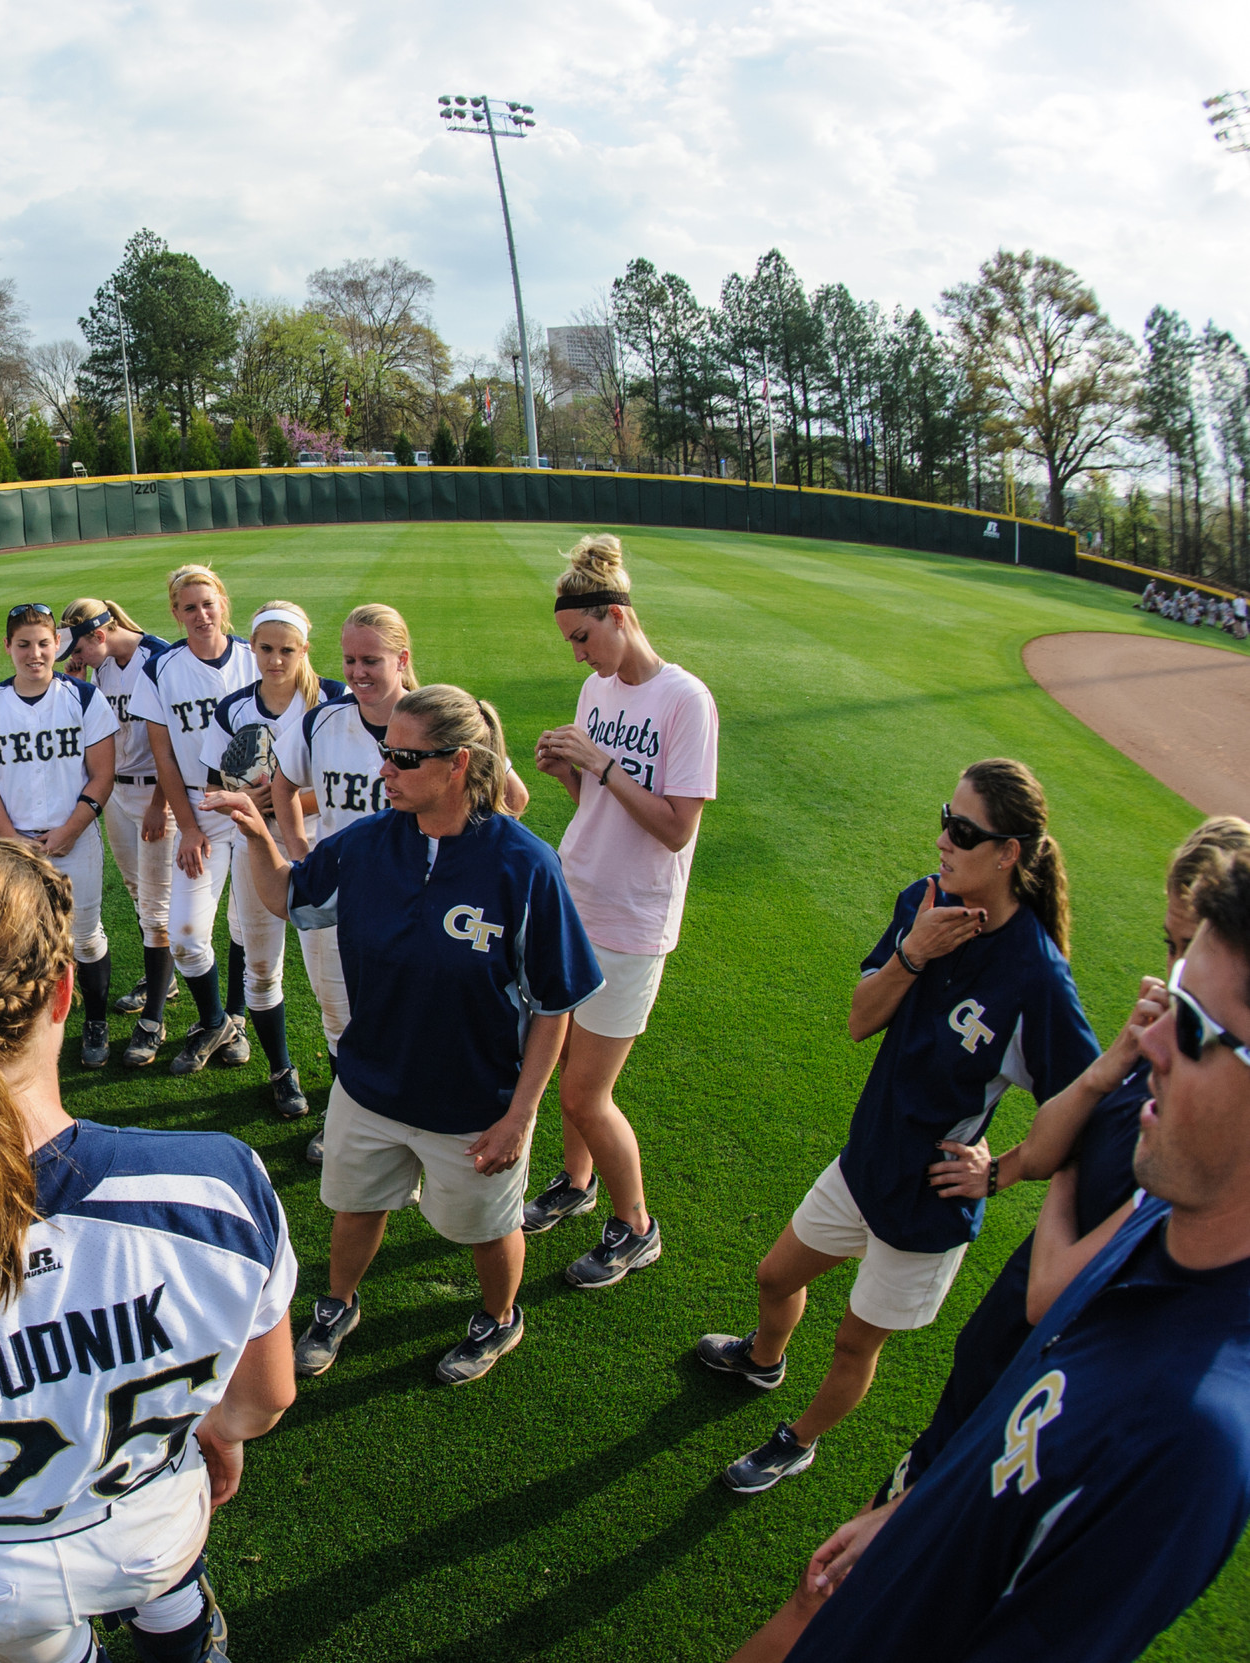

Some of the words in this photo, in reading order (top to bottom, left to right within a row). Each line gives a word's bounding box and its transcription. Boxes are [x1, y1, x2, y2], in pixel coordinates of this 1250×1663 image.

[134, 482, 157, 494] 220
[171, 697, 219, 733] TE
[587, 706, 660, 758] Jackets
[323, 770, 392, 814] TEC
[620, 756, 654, 793] 21
[443, 904, 505, 953] GT
[948, 998, 996, 1054] GT
[23, 1261, 63, 1280] RUSSELL
[991, 1369, 1066, 1499] GT
